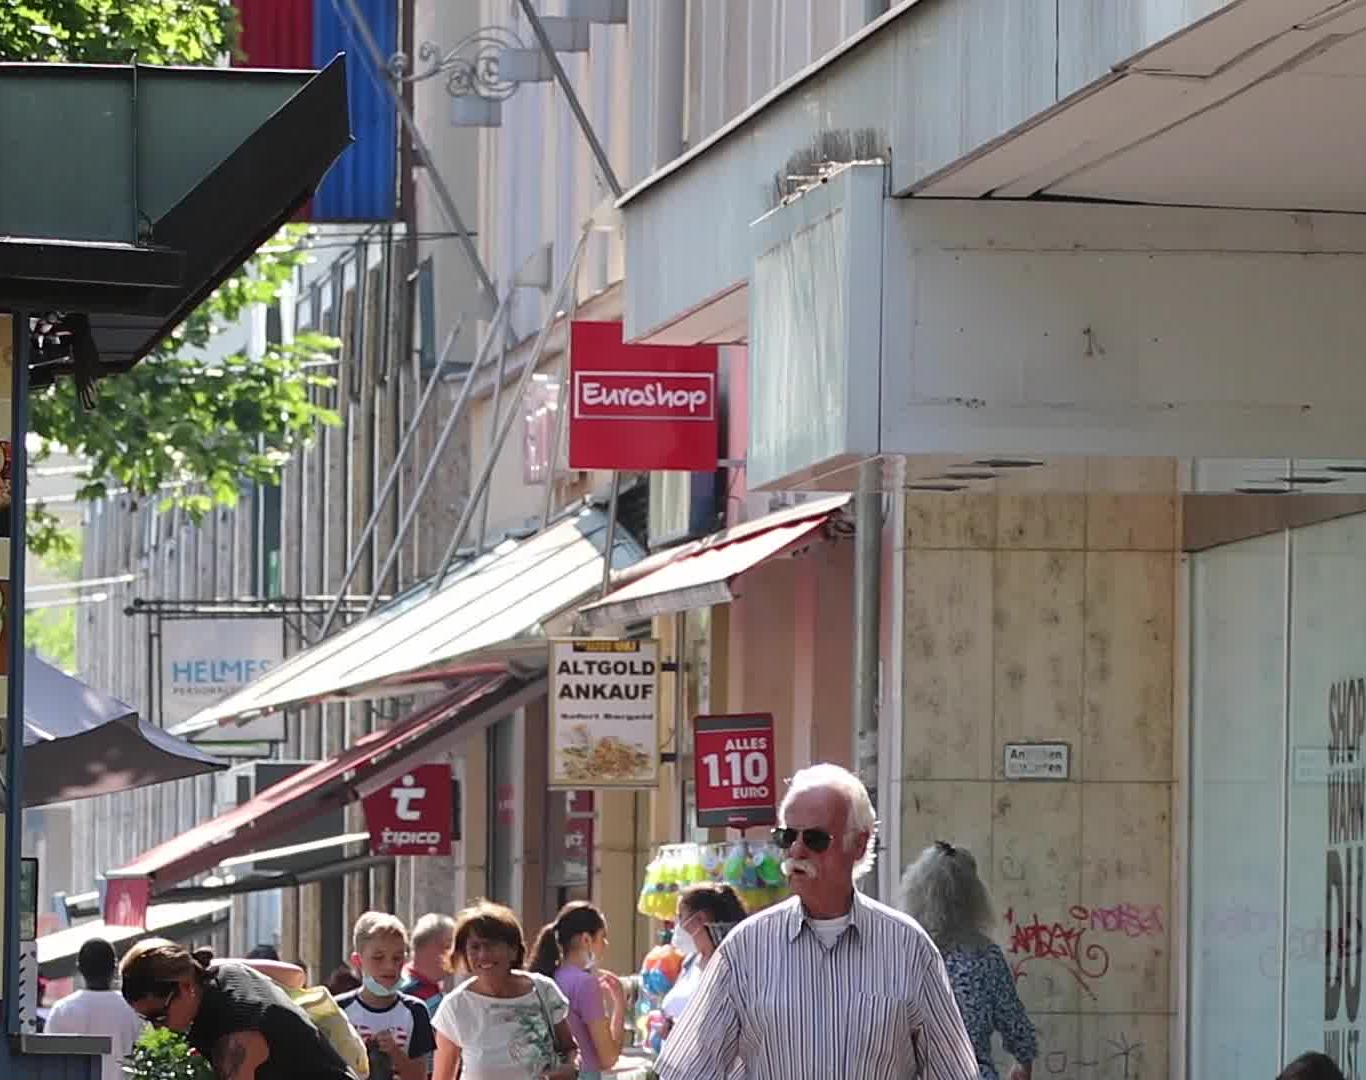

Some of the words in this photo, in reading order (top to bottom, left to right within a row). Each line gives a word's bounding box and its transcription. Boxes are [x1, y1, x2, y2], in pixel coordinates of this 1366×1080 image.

[582, 382, 708, 414] EuroShop
[558, 660, 655, 676] ALTGOLD
[559, 683, 654, 700] ANKAUF
[1328, 678, 1366, 767] SHOP
[724, 737, 767, 751] ALLES
[701, 751, 769, 788] 1.10
[732, 785, 770, 799] EURO
[380, 827, 442, 848] tipico
[1324, 846, 1364, 1023] DU
